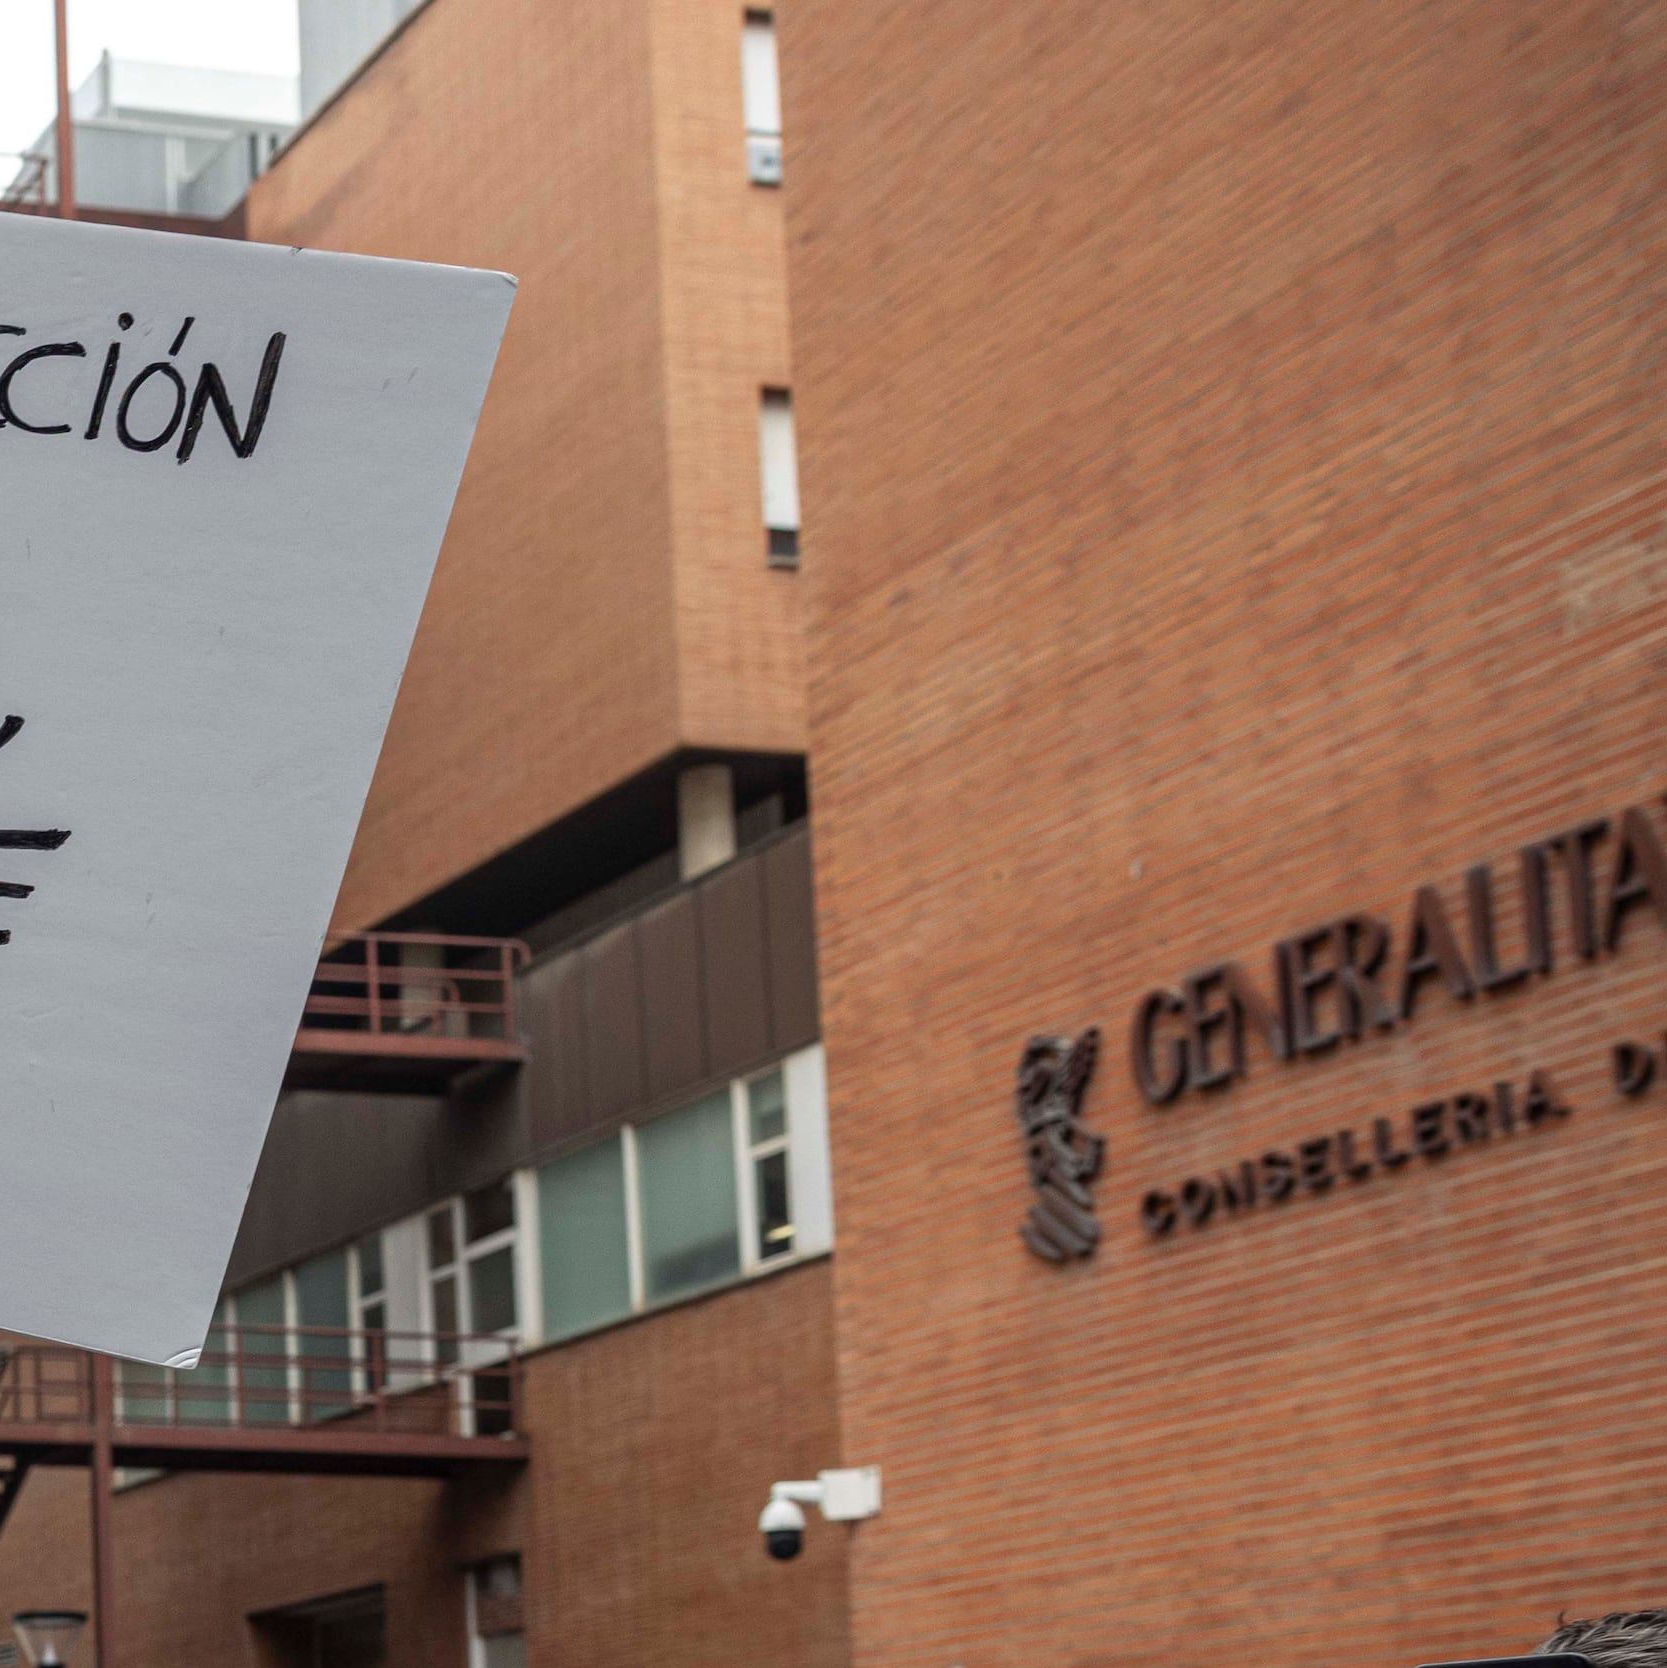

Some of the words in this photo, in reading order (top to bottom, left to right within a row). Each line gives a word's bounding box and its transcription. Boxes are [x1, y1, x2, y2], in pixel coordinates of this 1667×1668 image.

[1132, 791, 1667, 1108] GENERALITA
[1141, 1069, 1573, 1238] CONSELLERIA
[1613, 1030, 1667, 1099] D
